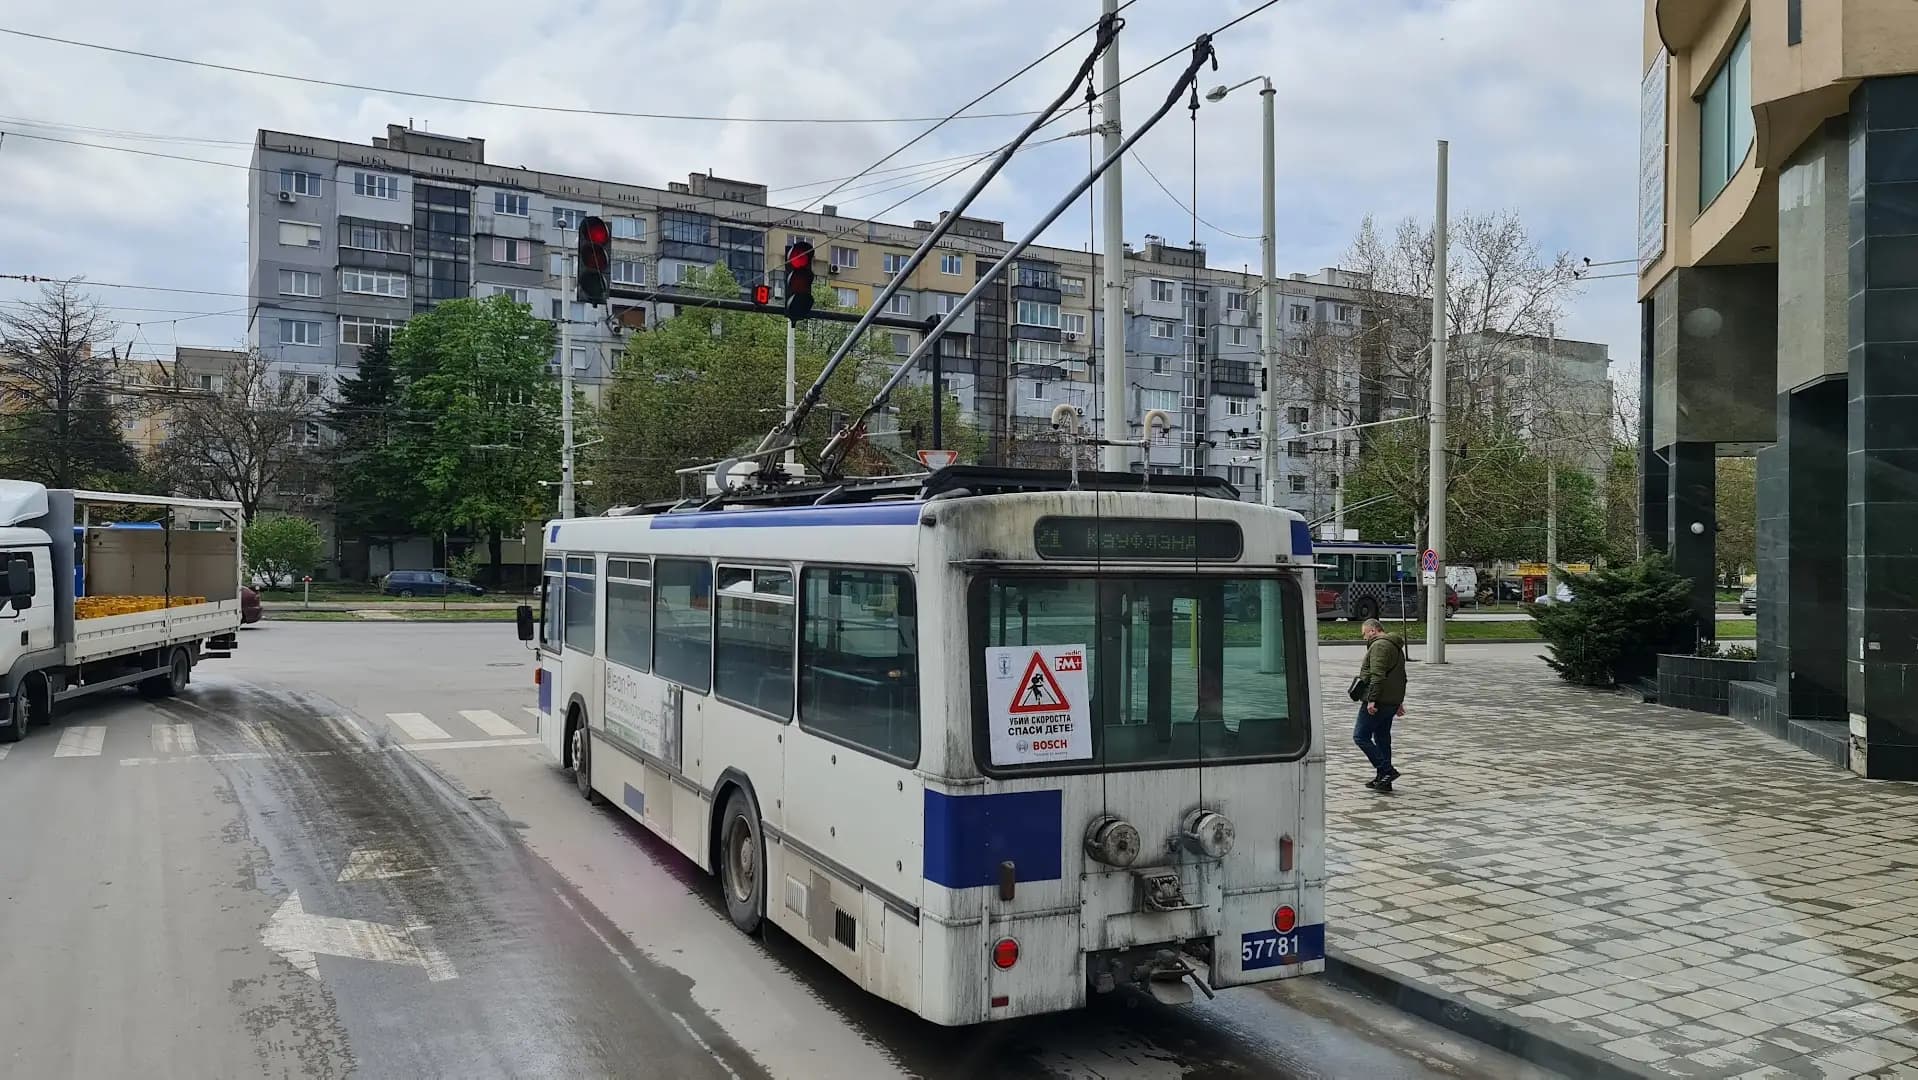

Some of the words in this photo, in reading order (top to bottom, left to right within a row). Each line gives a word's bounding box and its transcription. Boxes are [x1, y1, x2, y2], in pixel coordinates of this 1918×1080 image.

[1009, 716, 1029, 726] УБИЙ
[1031, 714, 1071, 725] СКОРОСТТА
[1008, 725, 1042, 736] СПАСИ
[1045, 723, 1073, 735] ДЕТЕ!
[1033, 739, 1067, 751] BOSCH
[1242, 935, 1298, 961] 57781
